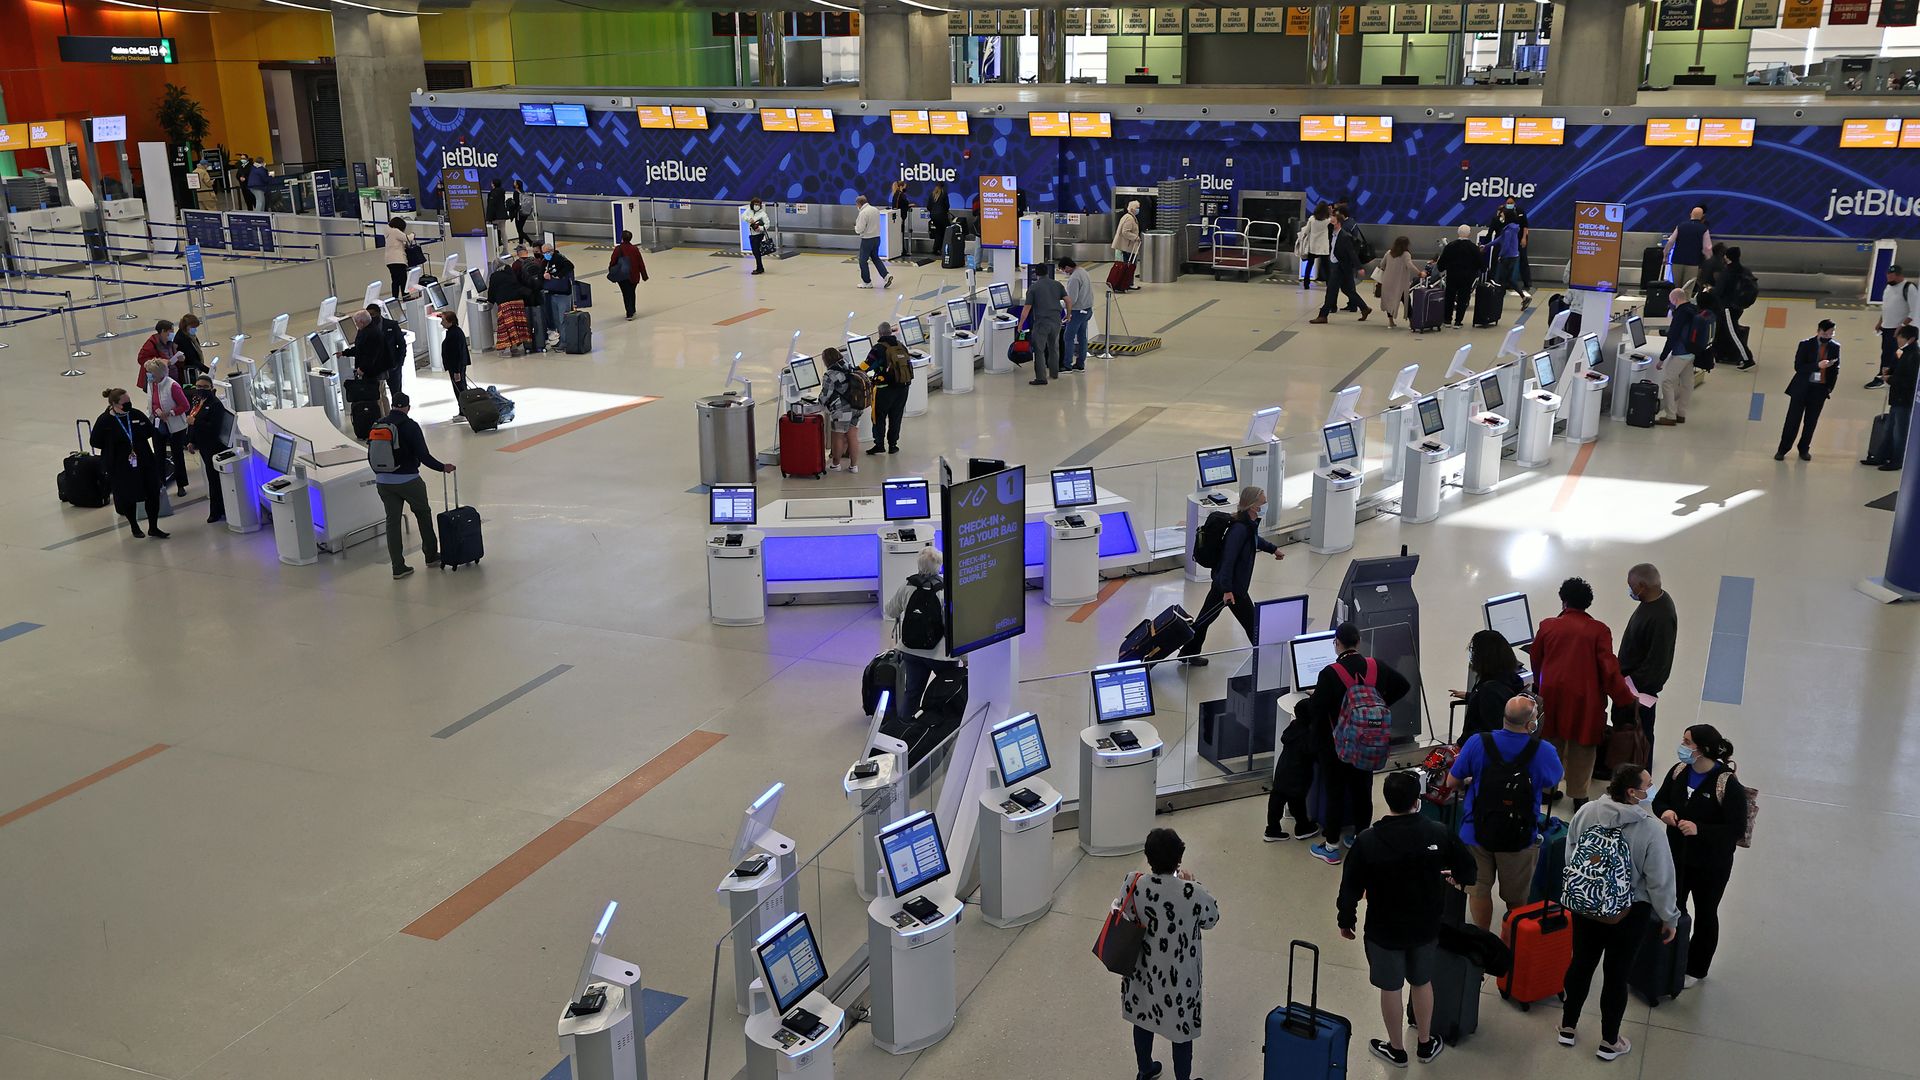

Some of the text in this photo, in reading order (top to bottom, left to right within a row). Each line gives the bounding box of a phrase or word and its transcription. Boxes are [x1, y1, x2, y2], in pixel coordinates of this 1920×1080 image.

[442, 146, 498, 169] jetBlue
[646, 160, 707, 185] jetBlue
[900, 163, 956, 182] jetBlue
[1007, 178, 1011, 187] 1
[1461, 176, 1536, 201] jetBlue
[1612, 208, 1617, 218] 1
[1006, 475, 1014, 495] 1
[959, 514, 998, 534] CHECK-IN
[959, 522, 1017, 548] TAG YOUR BAG
[959, 554, 986, 568] CHECK-IN
